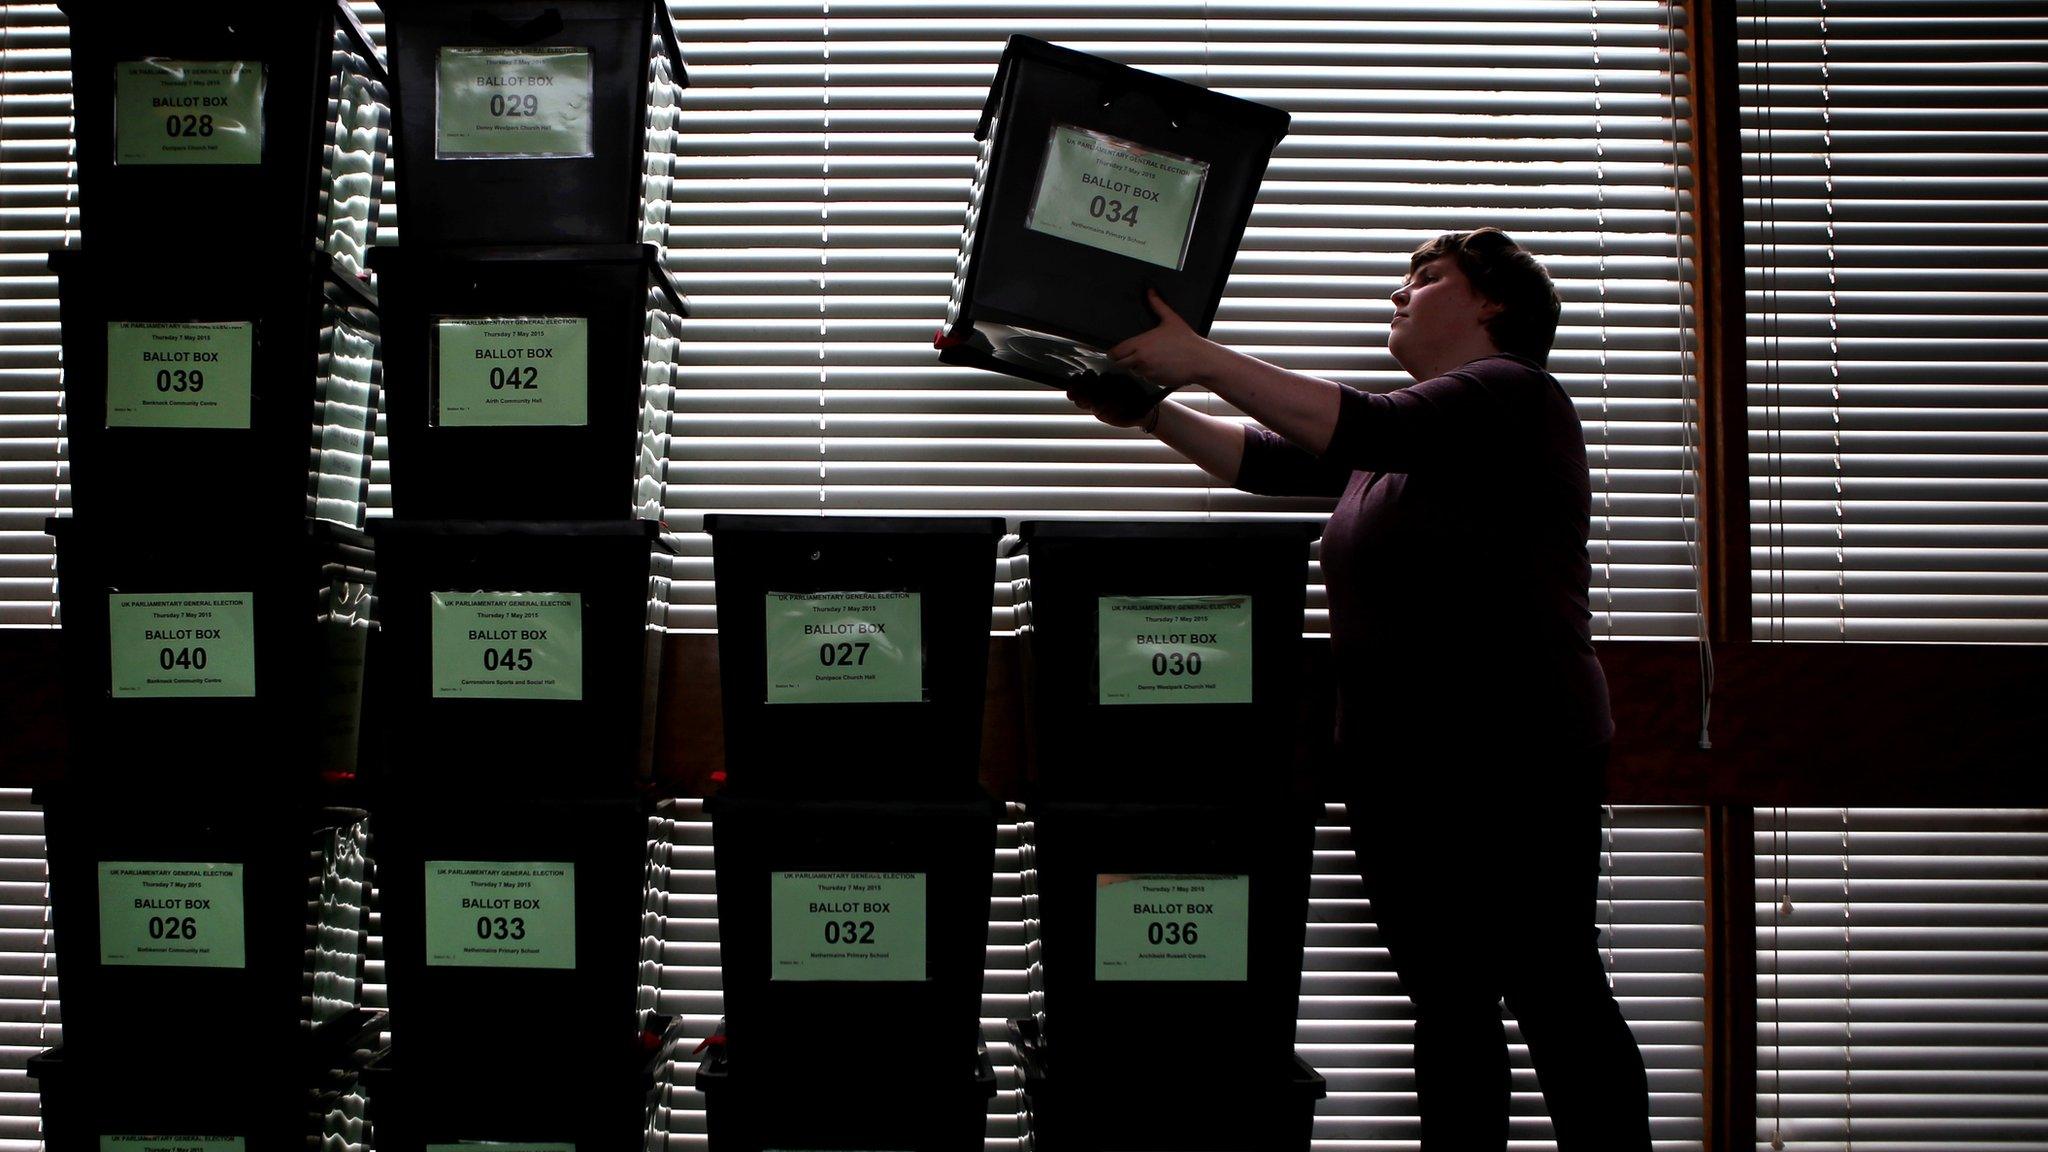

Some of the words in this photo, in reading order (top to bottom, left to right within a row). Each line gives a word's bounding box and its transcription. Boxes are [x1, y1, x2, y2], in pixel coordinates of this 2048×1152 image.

[477, 77, 523, 86] BALLOT
[529, 77, 553, 85] BOX
[153, 97, 199, 107] BALLOT
[203, 97, 228, 106] BOX
[490, 94, 538, 117] 029
[166, 114, 213, 137] 028
[1096, 159, 1124, 171] Thursday
[1128, 168, 1141, 176] May
[1082, 173, 1131, 194] BALLOT
[1133, 187, 1160, 202] BOX
[1090, 195, 1139, 227] 034
[144, 352, 190, 362] BALLOT
[194, 353, 218, 362] BOX
[476, 349, 523, 359] BALLOT
[528, 349, 552, 358] BOX
[157, 370, 203, 392] 039
[490, 367, 538, 390] 042
[146, 630, 191, 640] BALLOT
[196, 630, 220, 639] BOX
[469, 630, 517, 640] BALLOT
[522, 630, 547, 640] BOX
[805, 624, 854, 635] BALLOT
[859, 624, 885, 634] BOX
[1137, 634, 1186, 644] BALLOT
[1191, 634, 1216, 644] BOX
[160, 647, 207, 670] 040
[484, 648, 532, 671] 045
[820, 643, 870, 666] 027
[1152, 652, 1201, 676] 030
[135, 899, 181, 909] BALLOT
[186, 900, 210, 909] BOX
[463, 899, 510, 909] BALLOT
[514, 900, 540, 909] BOX
[810, 903, 859, 913] BALLOT
[864, 903, 890, 913] BOX
[1134, 904, 1183, 914] BALLOT
[1187, 904, 1213, 914] BOX
[150, 917, 196, 939] 026
[477, 916, 525, 940] 033
[825, 921, 875, 944] 032
[1148, 922, 1198, 945] 036
